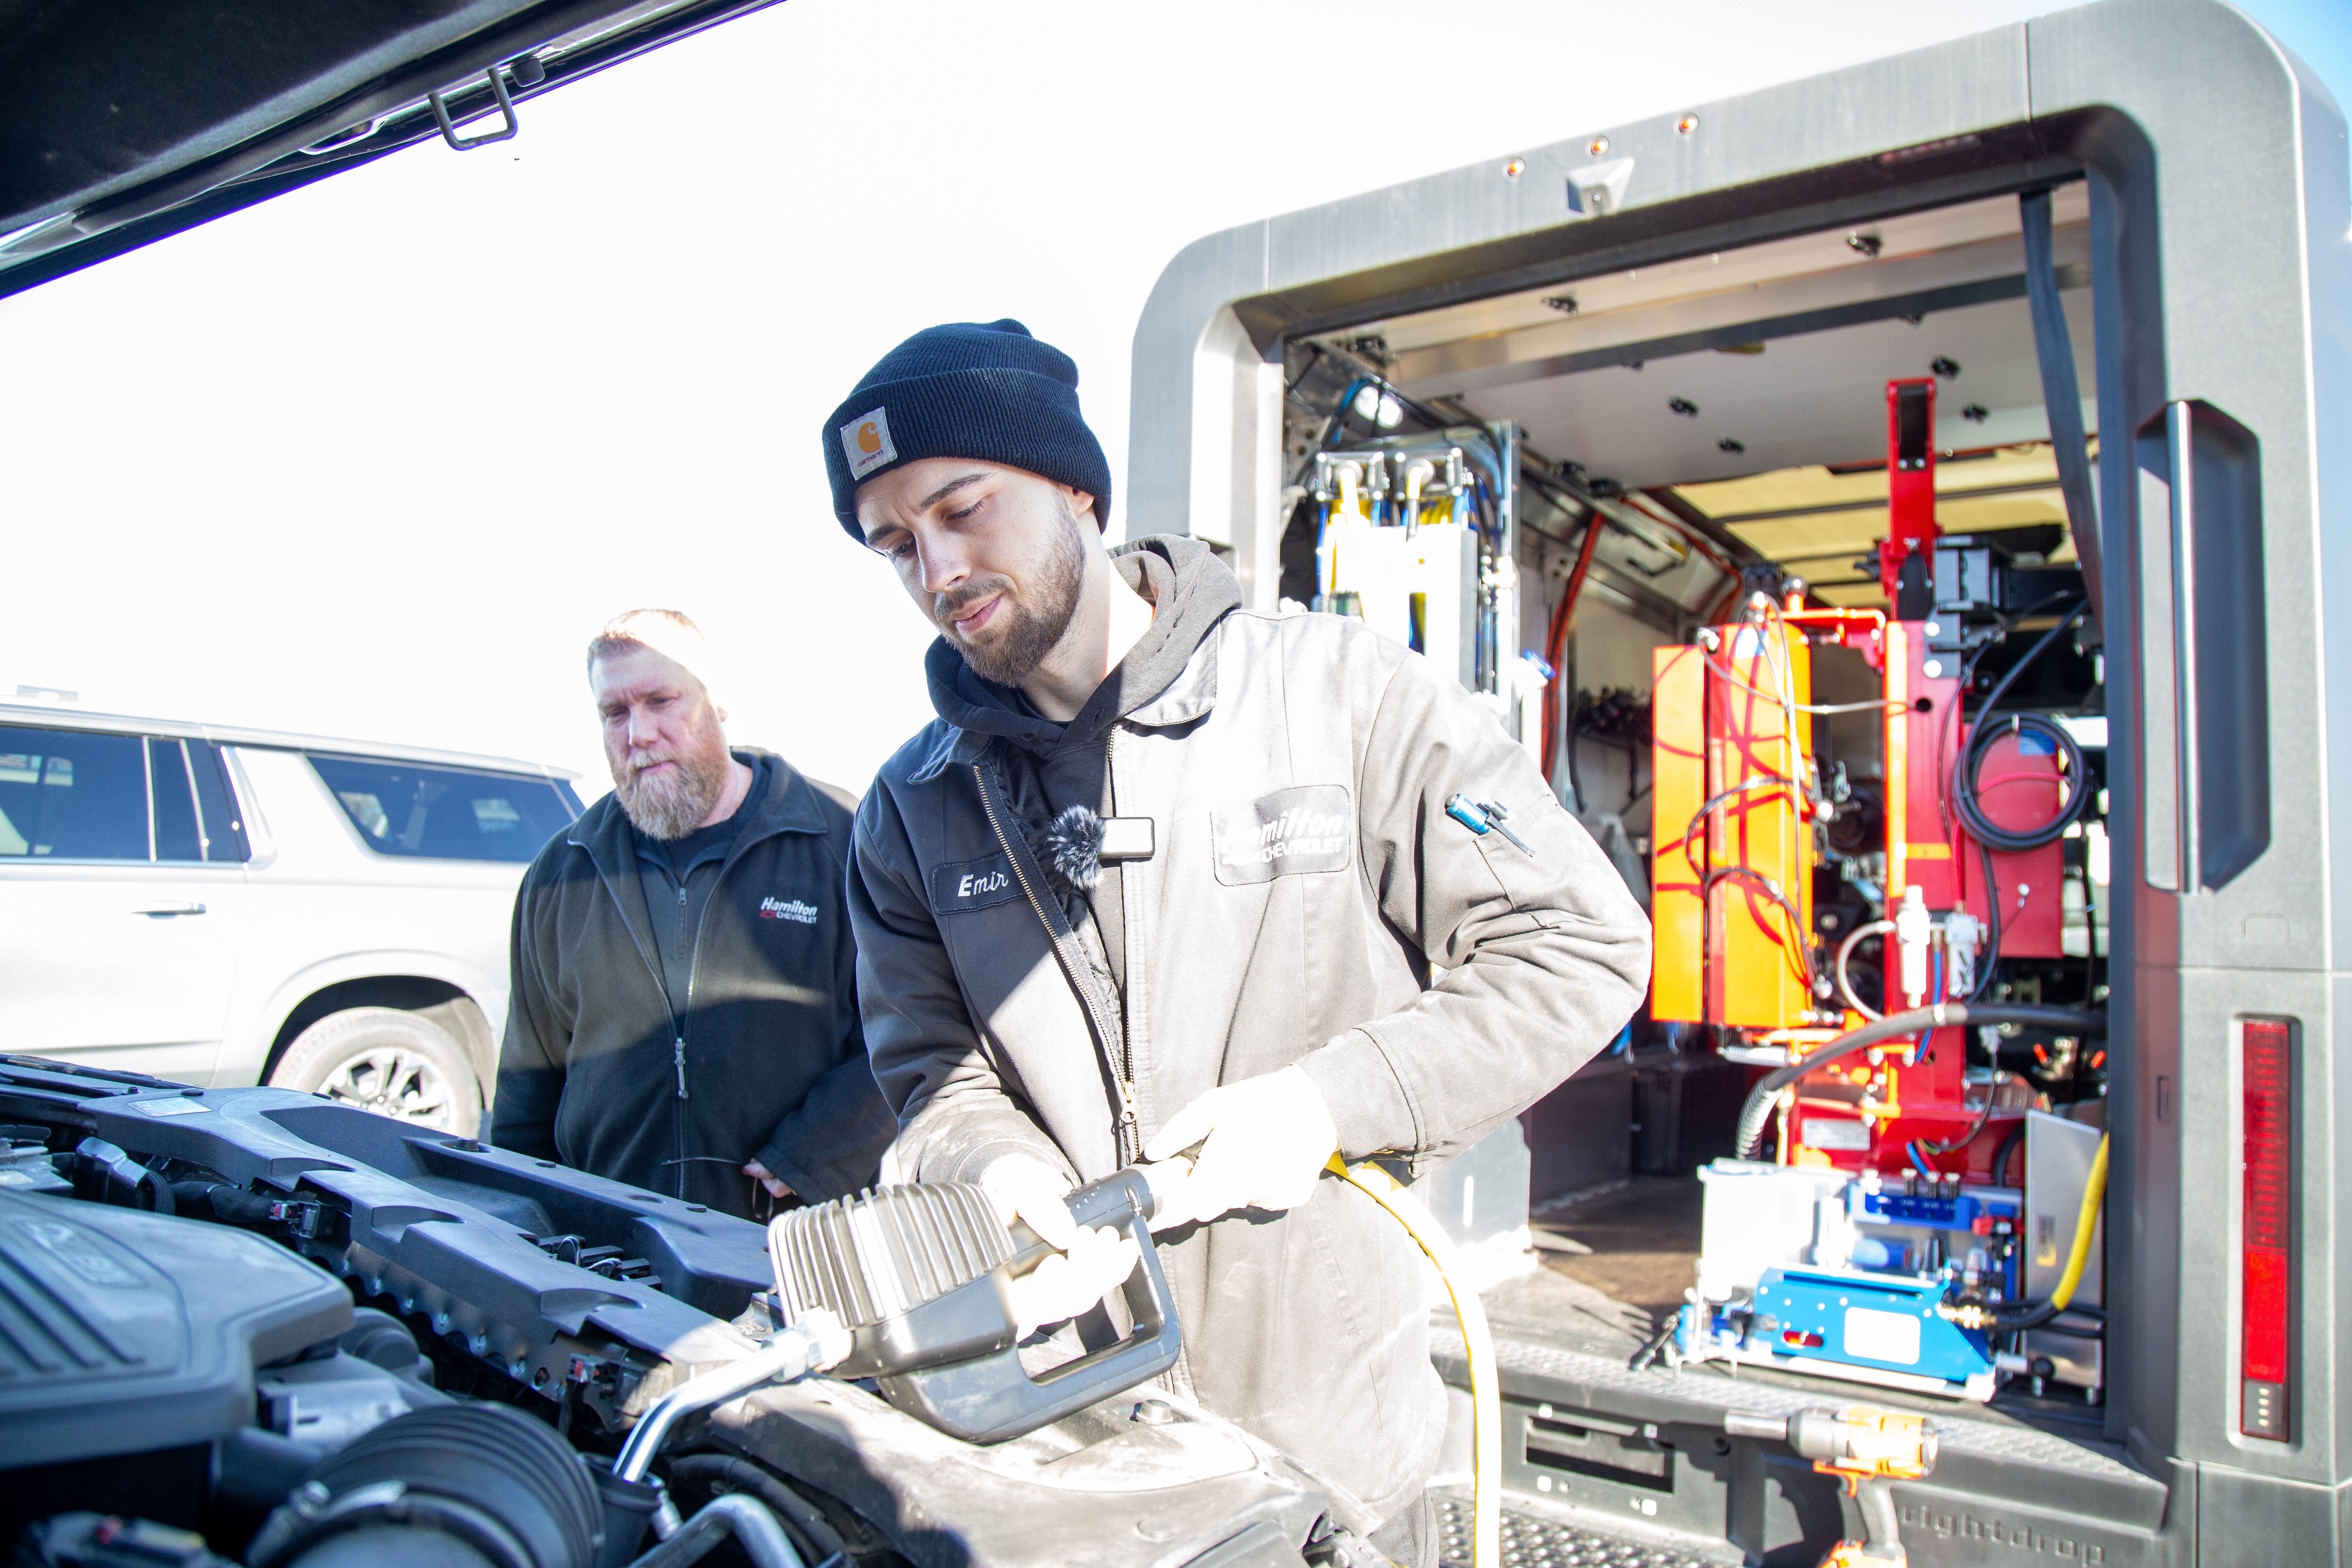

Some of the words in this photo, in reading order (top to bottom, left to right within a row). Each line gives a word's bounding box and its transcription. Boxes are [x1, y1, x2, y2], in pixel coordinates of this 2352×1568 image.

[858, 450, 883, 466] carhartt
[1222, 807, 1344, 851] milton
[957, 871, 1009, 897] Emir
[760, 896, 817, 916] Hamilton
[776, 911, 817, 924] CHEVROLET
[1900, 1505, 2105, 1568] rightdrop
